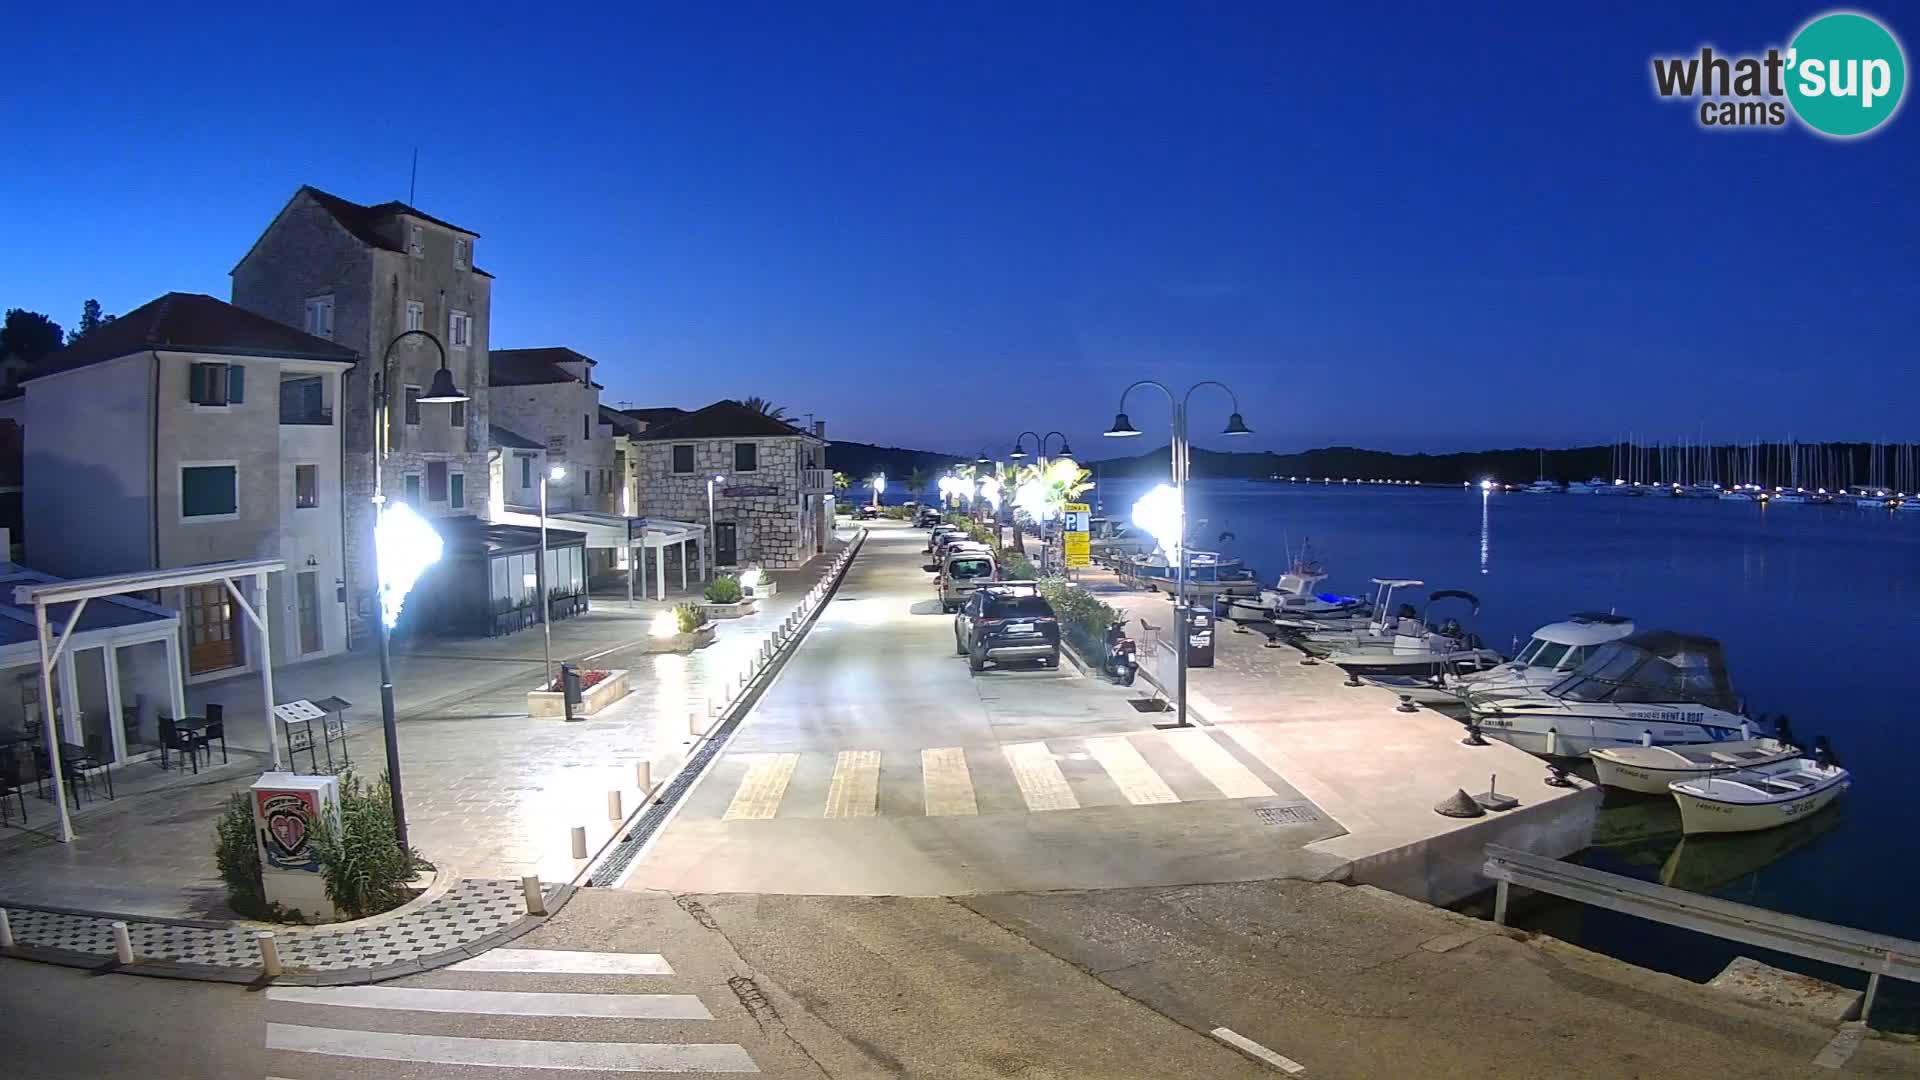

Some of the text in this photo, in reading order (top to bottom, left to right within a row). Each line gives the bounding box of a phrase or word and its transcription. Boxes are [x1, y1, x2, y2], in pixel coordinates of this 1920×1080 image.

[1065, 513, 1076, 531] P
[1661, 711, 1680, 721] RENT
[1686, 712, 1705, 723] BOAT
